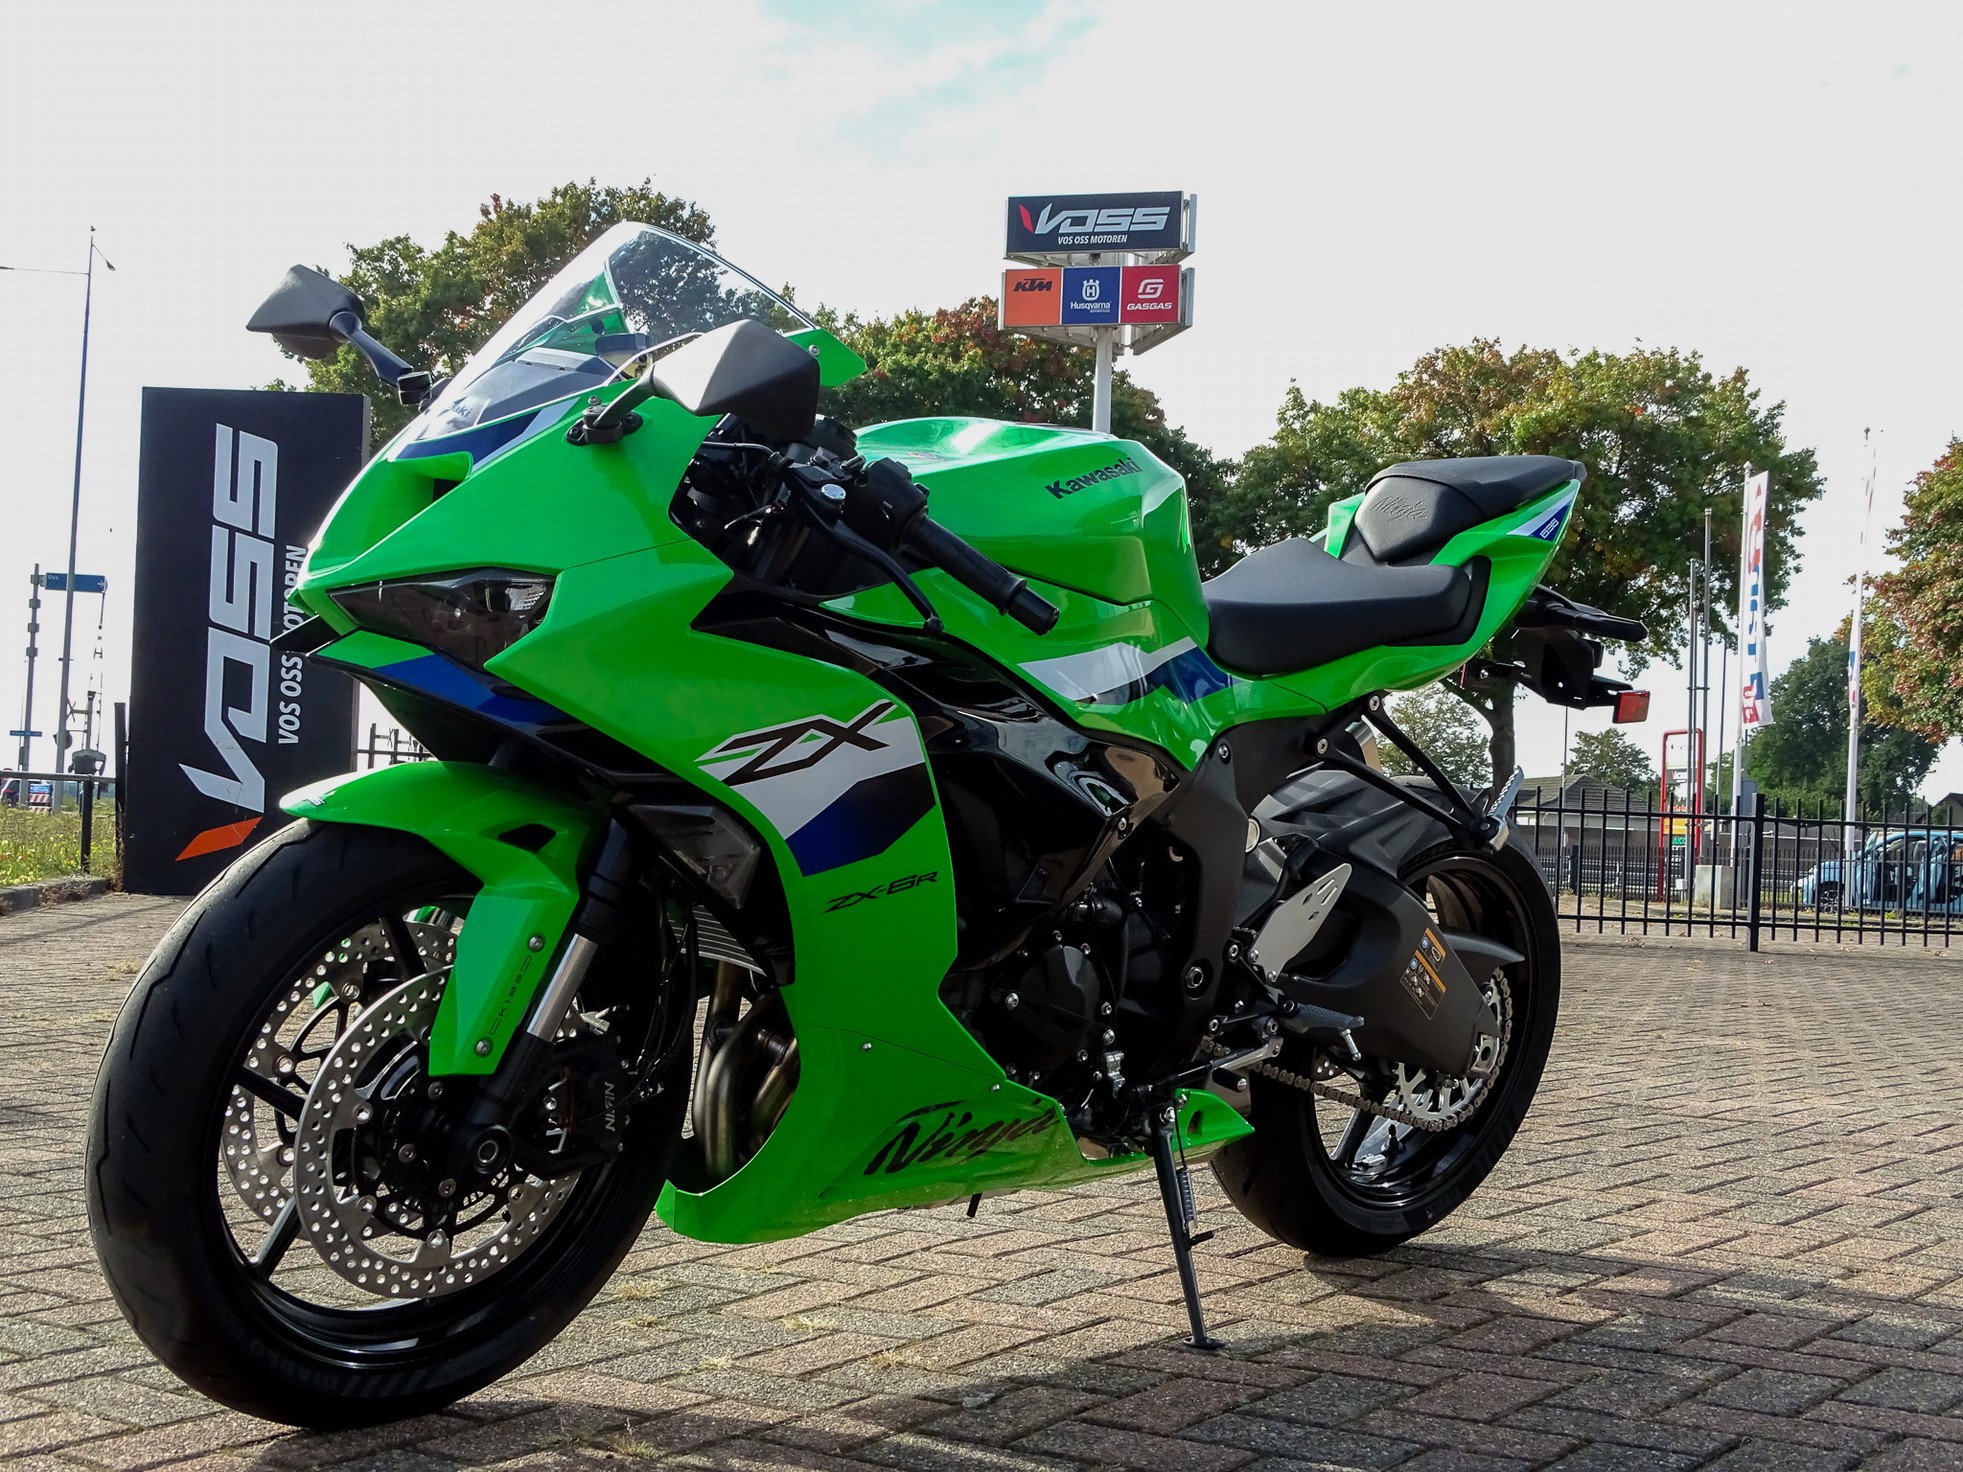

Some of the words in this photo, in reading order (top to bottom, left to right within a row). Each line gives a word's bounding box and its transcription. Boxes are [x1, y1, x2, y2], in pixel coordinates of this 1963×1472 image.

[1035, 203, 1170, 234] VOSS
[1058, 236, 1074, 245] VOS
[1074, 235, 1089, 245] OSS
[1089, 234, 1128, 244] MOTOREN
[1013, 278, 1053, 292] KTM
[1070, 301, 1110, 311] Husqvarna
[1127, 303, 1173, 311] GASGAS
[1045, 457, 1143, 499] Kawasaki
[1369, 496, 1429, 522] Ninja
[283, 545, 308, 635] OTREN
[179, 423, 279, 814] VOSS
[280, 654, 303, 698] OSS
[278, 701, 301, 744] VOS
[699, 699, 896, 787] ZX
[822, 871, 938, 914] ZX-6R
[863, 1098, 1061, 1175] Ninja
